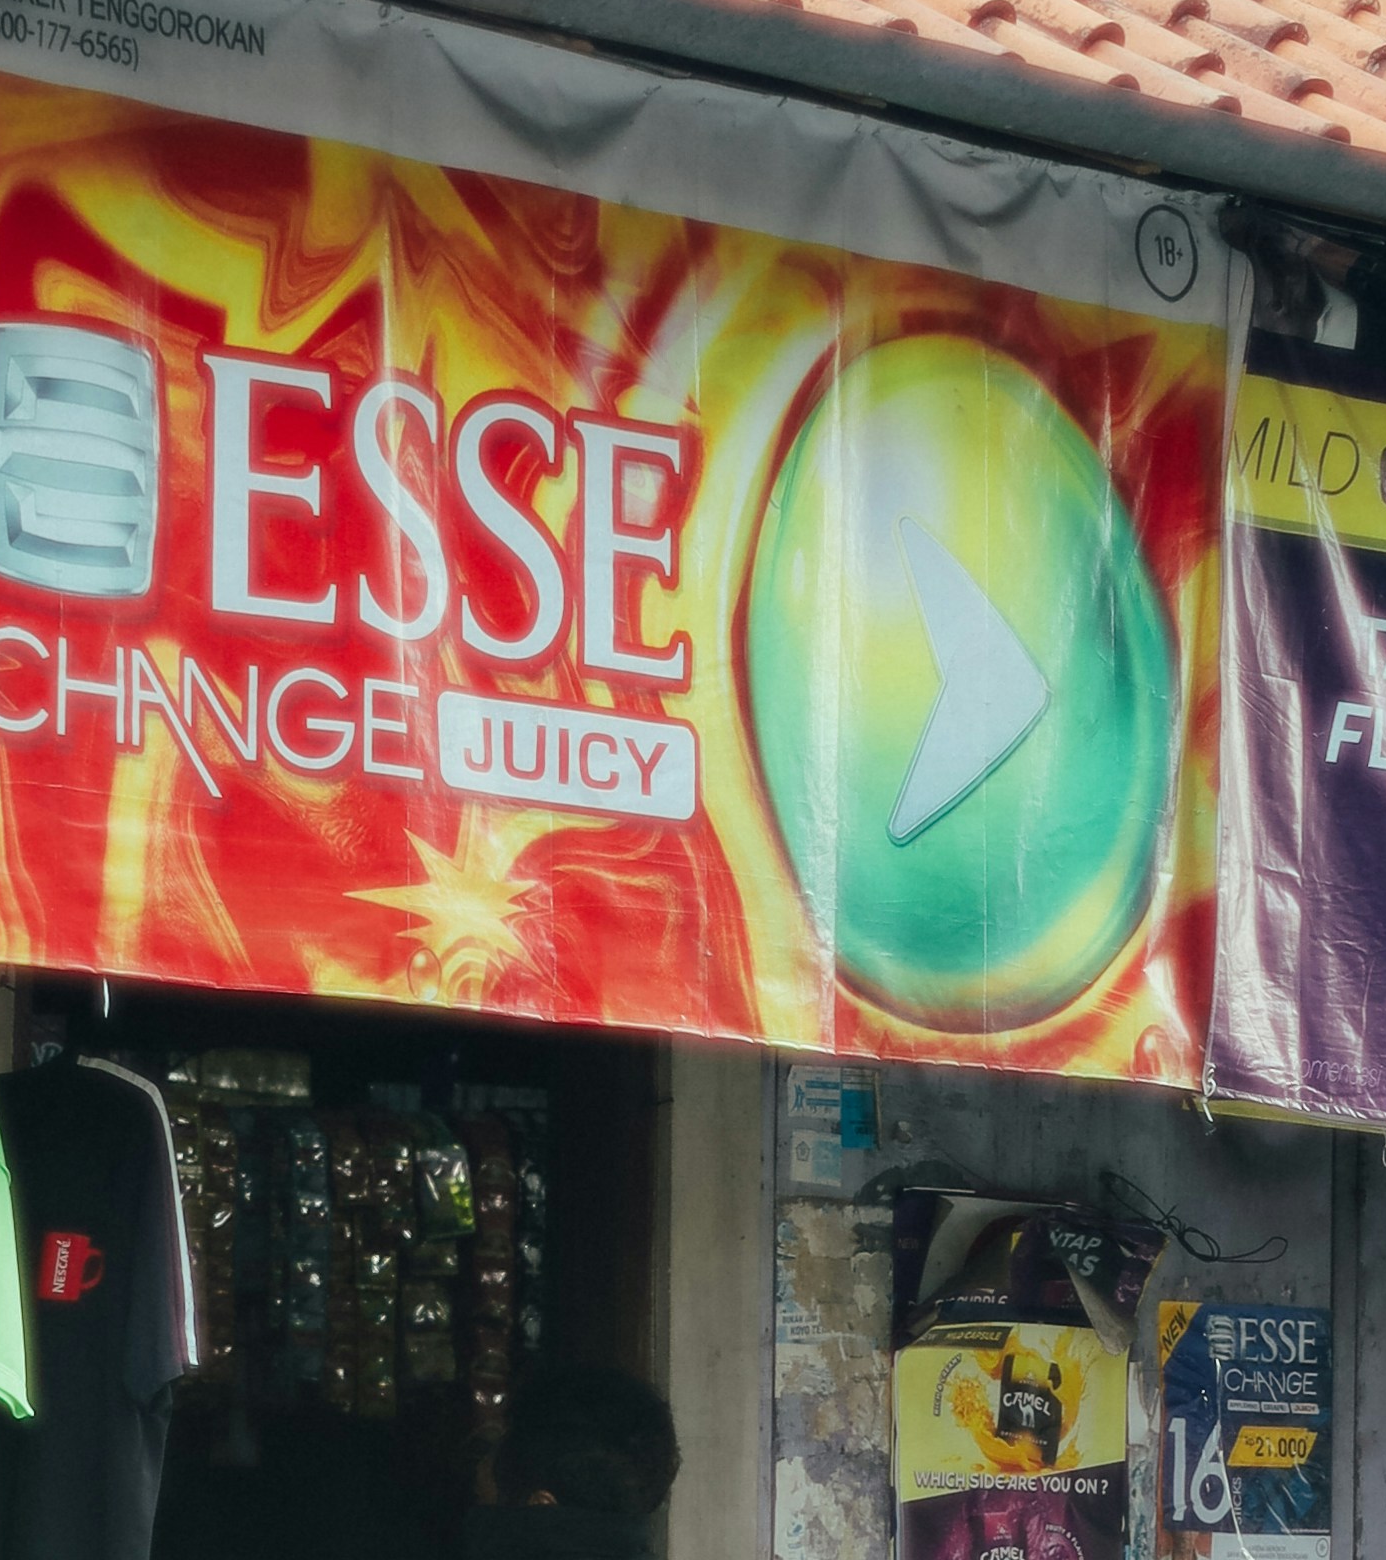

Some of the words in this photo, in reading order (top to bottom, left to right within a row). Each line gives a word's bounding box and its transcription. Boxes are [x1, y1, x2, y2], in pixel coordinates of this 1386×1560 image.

[1155, 235, 1183, 267] 18+
[1233, 416, 1361, 496] MILD
[203, 353, 685, 680] ESSE
[463, 716, 669, 796] JUICY
[52, 1238, 72, 1294] NESCAFÉ
[964, 1329, 1003, 1342] CAPSULE
[1162, 1305, 1187, 1353] NEW
[1238, 1317, 1318, 1364] ESSE
[1002, 1391, 1052, 1417] CAMEL
[1224, 1368, 1318, 1402] CHANGE
[914, 1471, 966, 1489] WHICH
[969, 1472, 1007, 1489] SIDE
[1007, 1474, 1038, 1489] ARE
[1041, 1476, 1071, 1493] YOU
[1074, 1478, 1098, 1494] ON
[1168, 1417, 1232, 1524] 16
